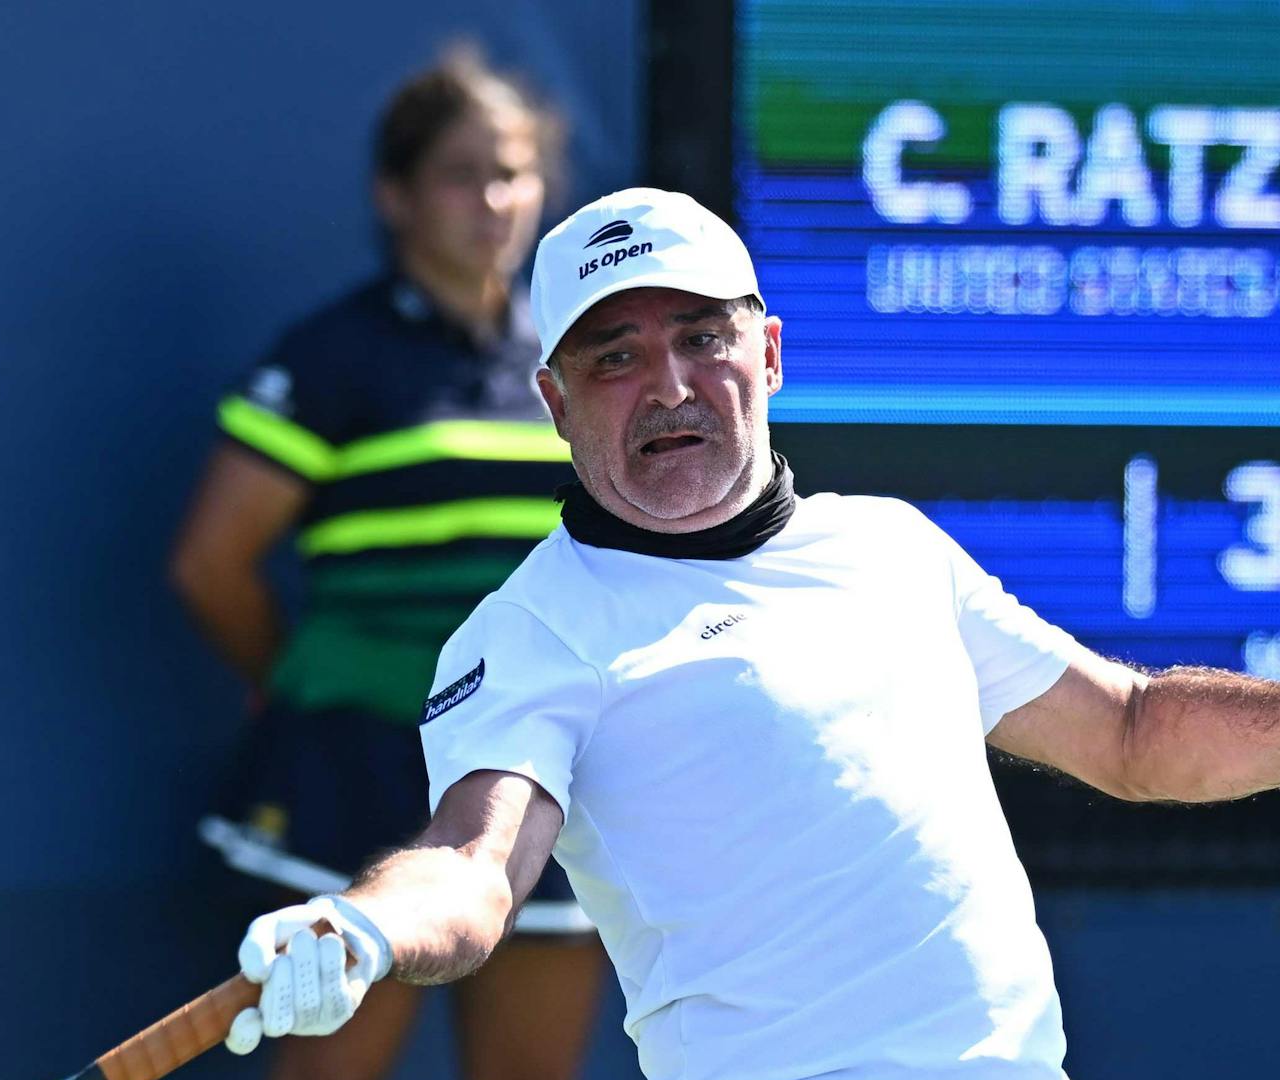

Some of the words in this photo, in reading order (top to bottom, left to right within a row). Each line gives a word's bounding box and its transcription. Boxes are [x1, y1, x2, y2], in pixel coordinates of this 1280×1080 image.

[862, 98, 972, 226] C.
[579, 258, 599, 280] us
[601, 241, 653, 267] open
[701, 612, 748, 640] circle
